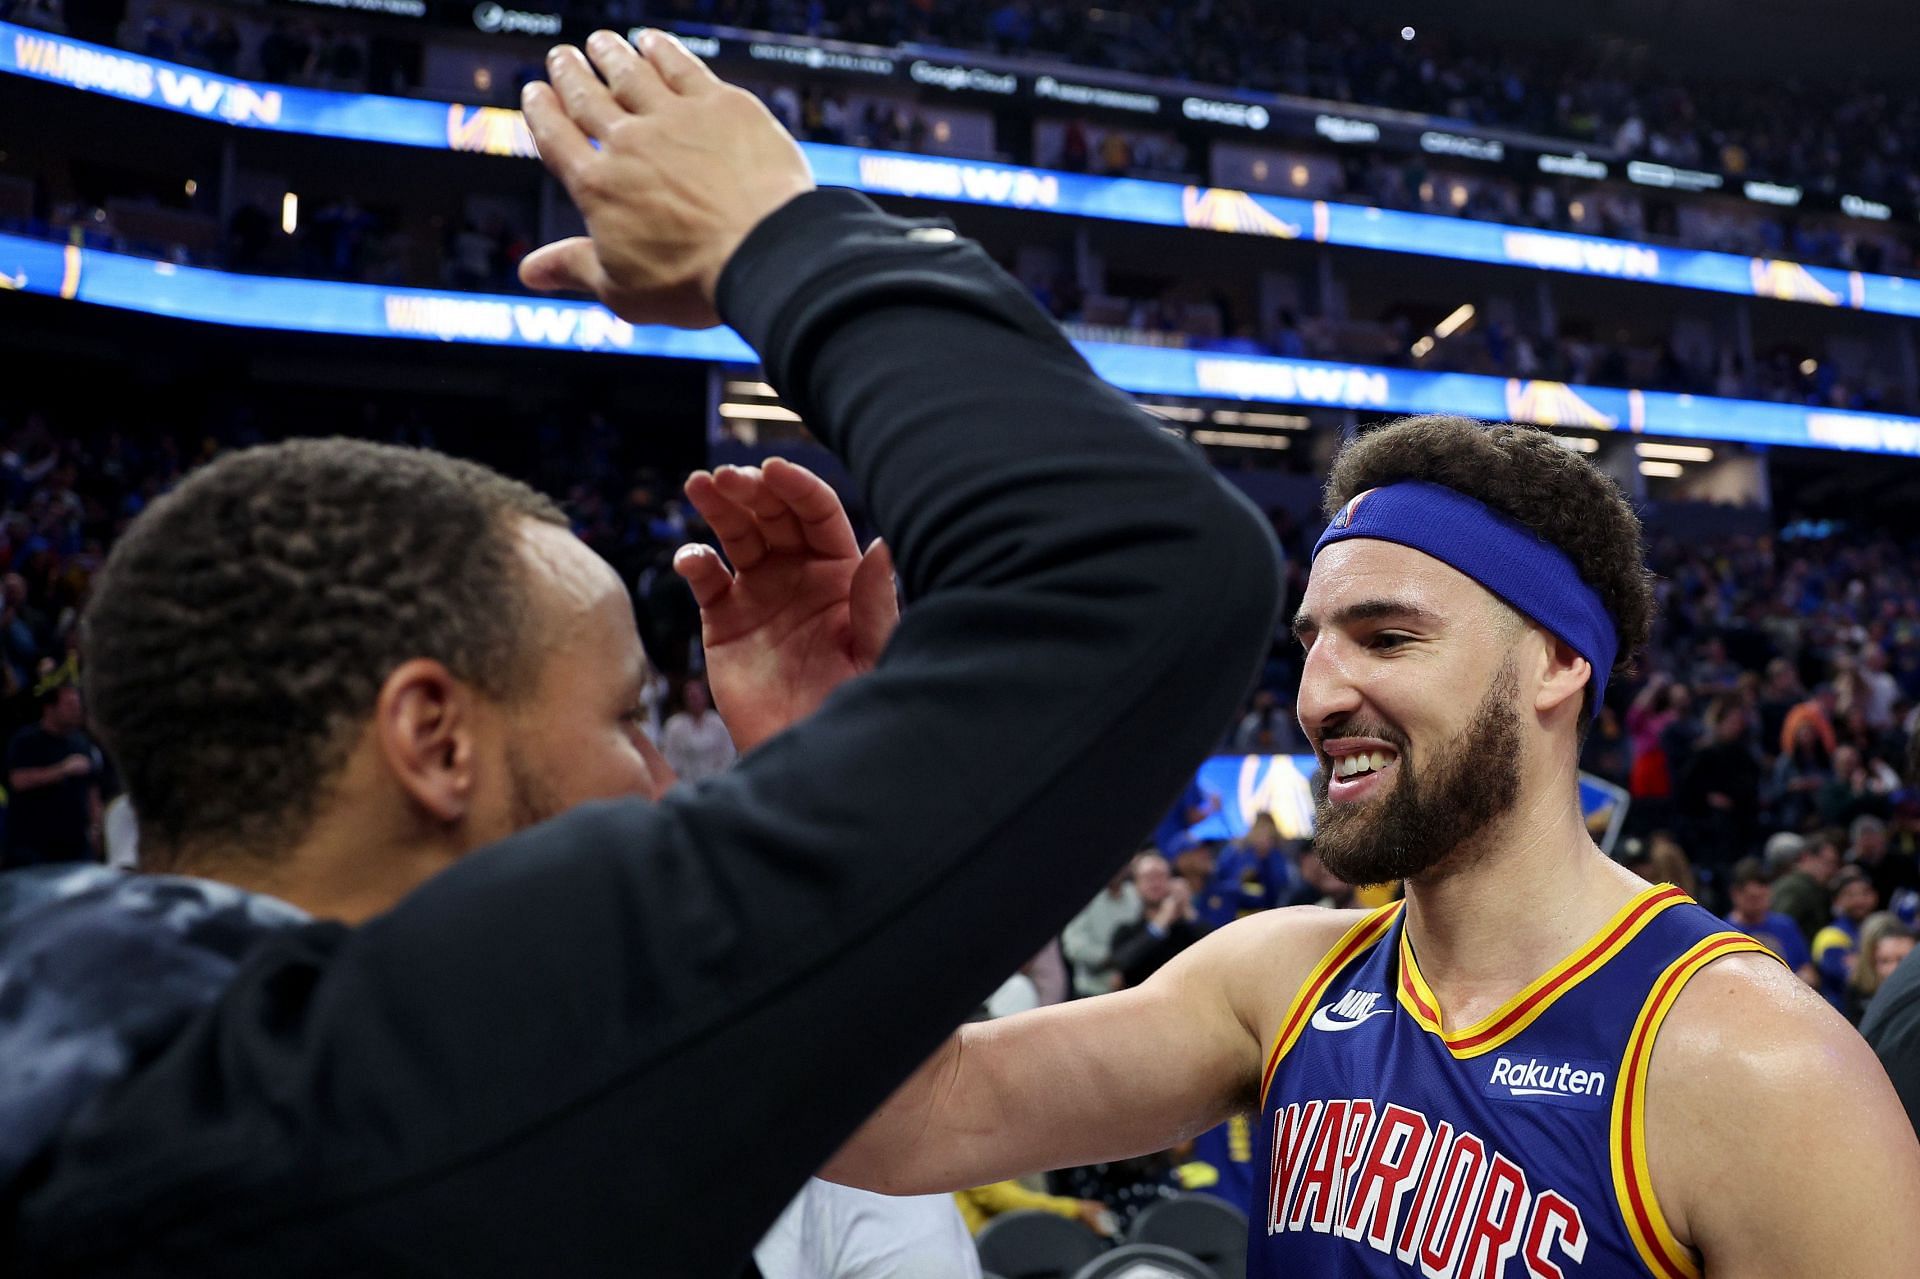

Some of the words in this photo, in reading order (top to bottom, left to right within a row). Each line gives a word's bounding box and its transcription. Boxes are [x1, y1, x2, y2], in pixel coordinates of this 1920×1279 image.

[15, 34, 153, 98] WARRIORS
[157, 69, 282, 123] WIN
[1330, 989, 1382, 1019] NIKE
[1489, 1058, 1606, 1096] Rakuten
[1268, 1099, 1588, 1279] WARRIORS
